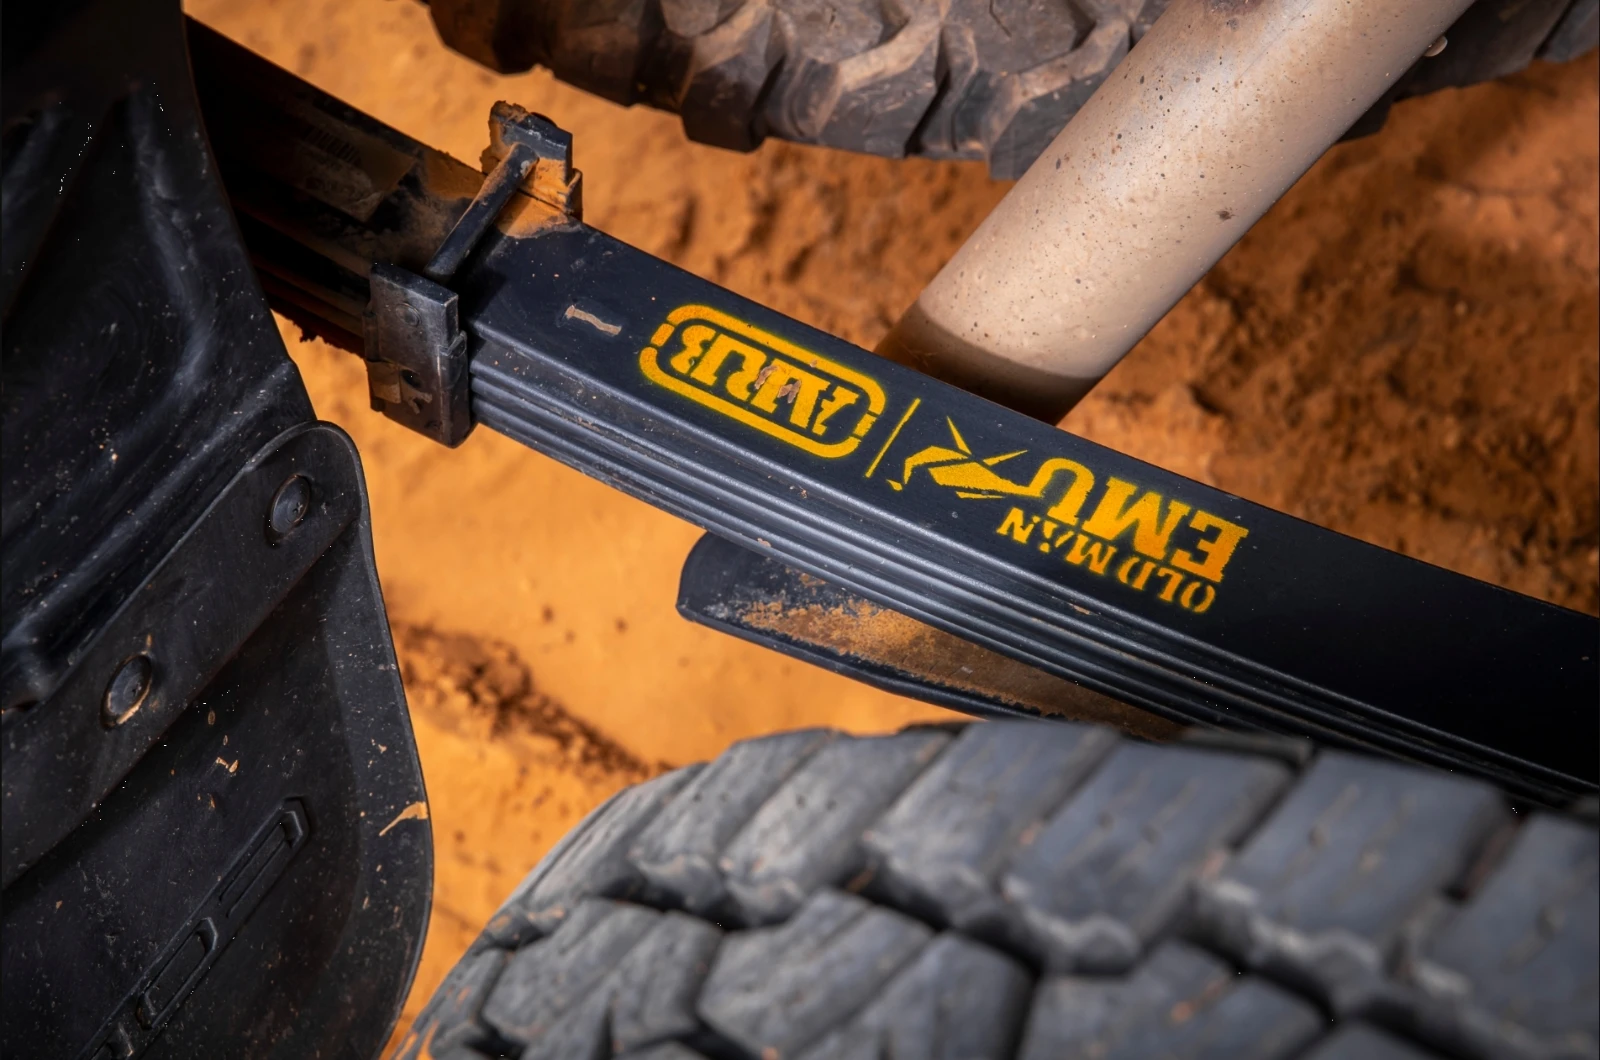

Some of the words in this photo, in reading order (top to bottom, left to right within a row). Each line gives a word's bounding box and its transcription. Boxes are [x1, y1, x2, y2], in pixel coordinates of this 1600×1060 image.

[670, 324, 859, 436] ARB
[997, 507, 1117, 574] MAN
[1028, 457, 1249, 583] EMU
[1117, 556, 1216, 613] OLD
